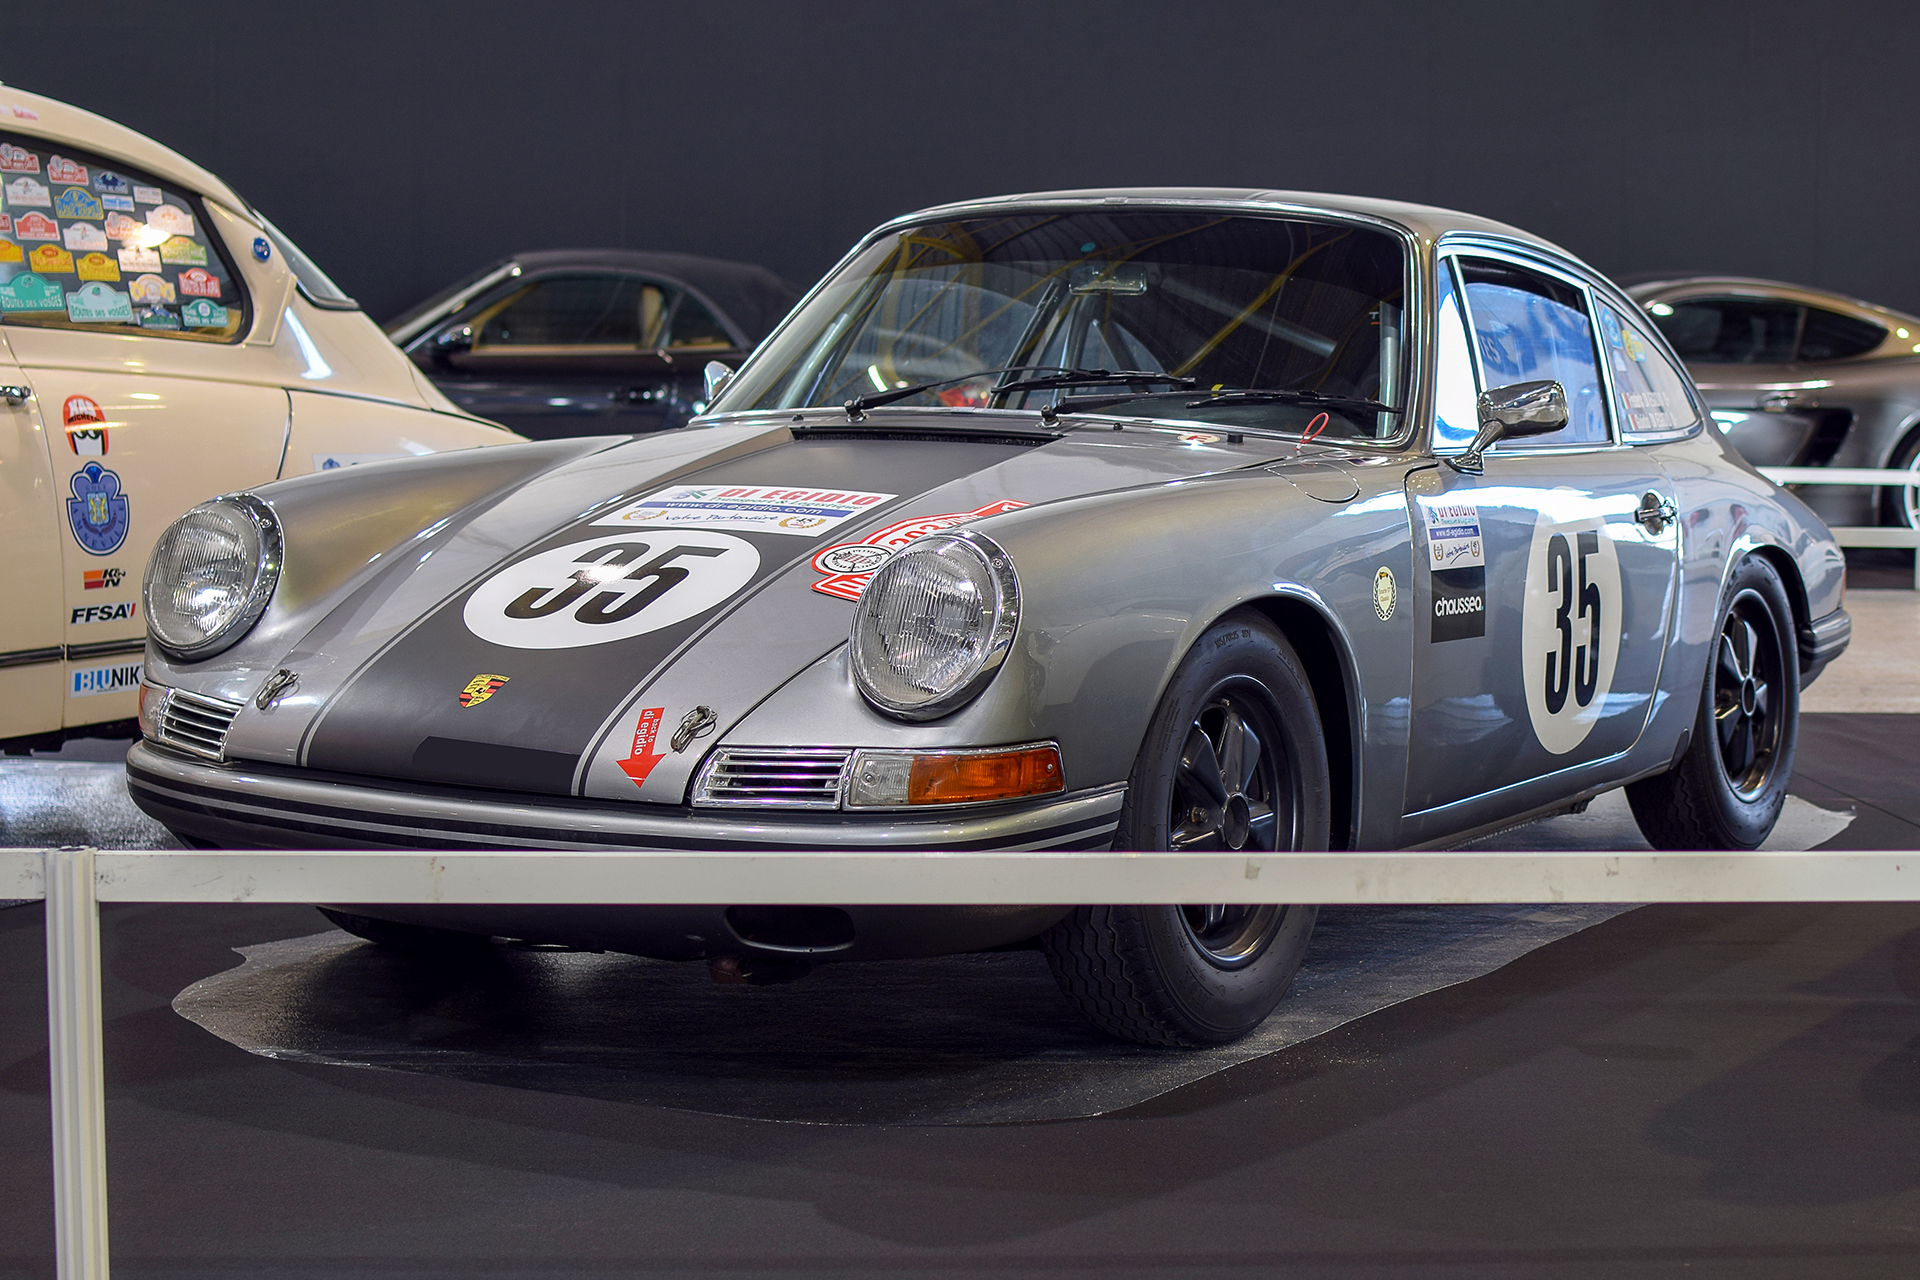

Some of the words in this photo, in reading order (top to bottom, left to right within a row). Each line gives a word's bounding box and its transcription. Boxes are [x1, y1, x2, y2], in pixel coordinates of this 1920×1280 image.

[666, 501, 823, 515] www.di-egidio.com
[717, 488, 760, 498] DI
[762, 490, 882, 506] EGIDIO
[503, 541, 731, 625] 35
[71, 604, 127, 624] FFSA
[1544, 530, 1601, 716] 35
[74, 666, 140, 692] BLUNIK
[634, 722, 649, 755] egidio
